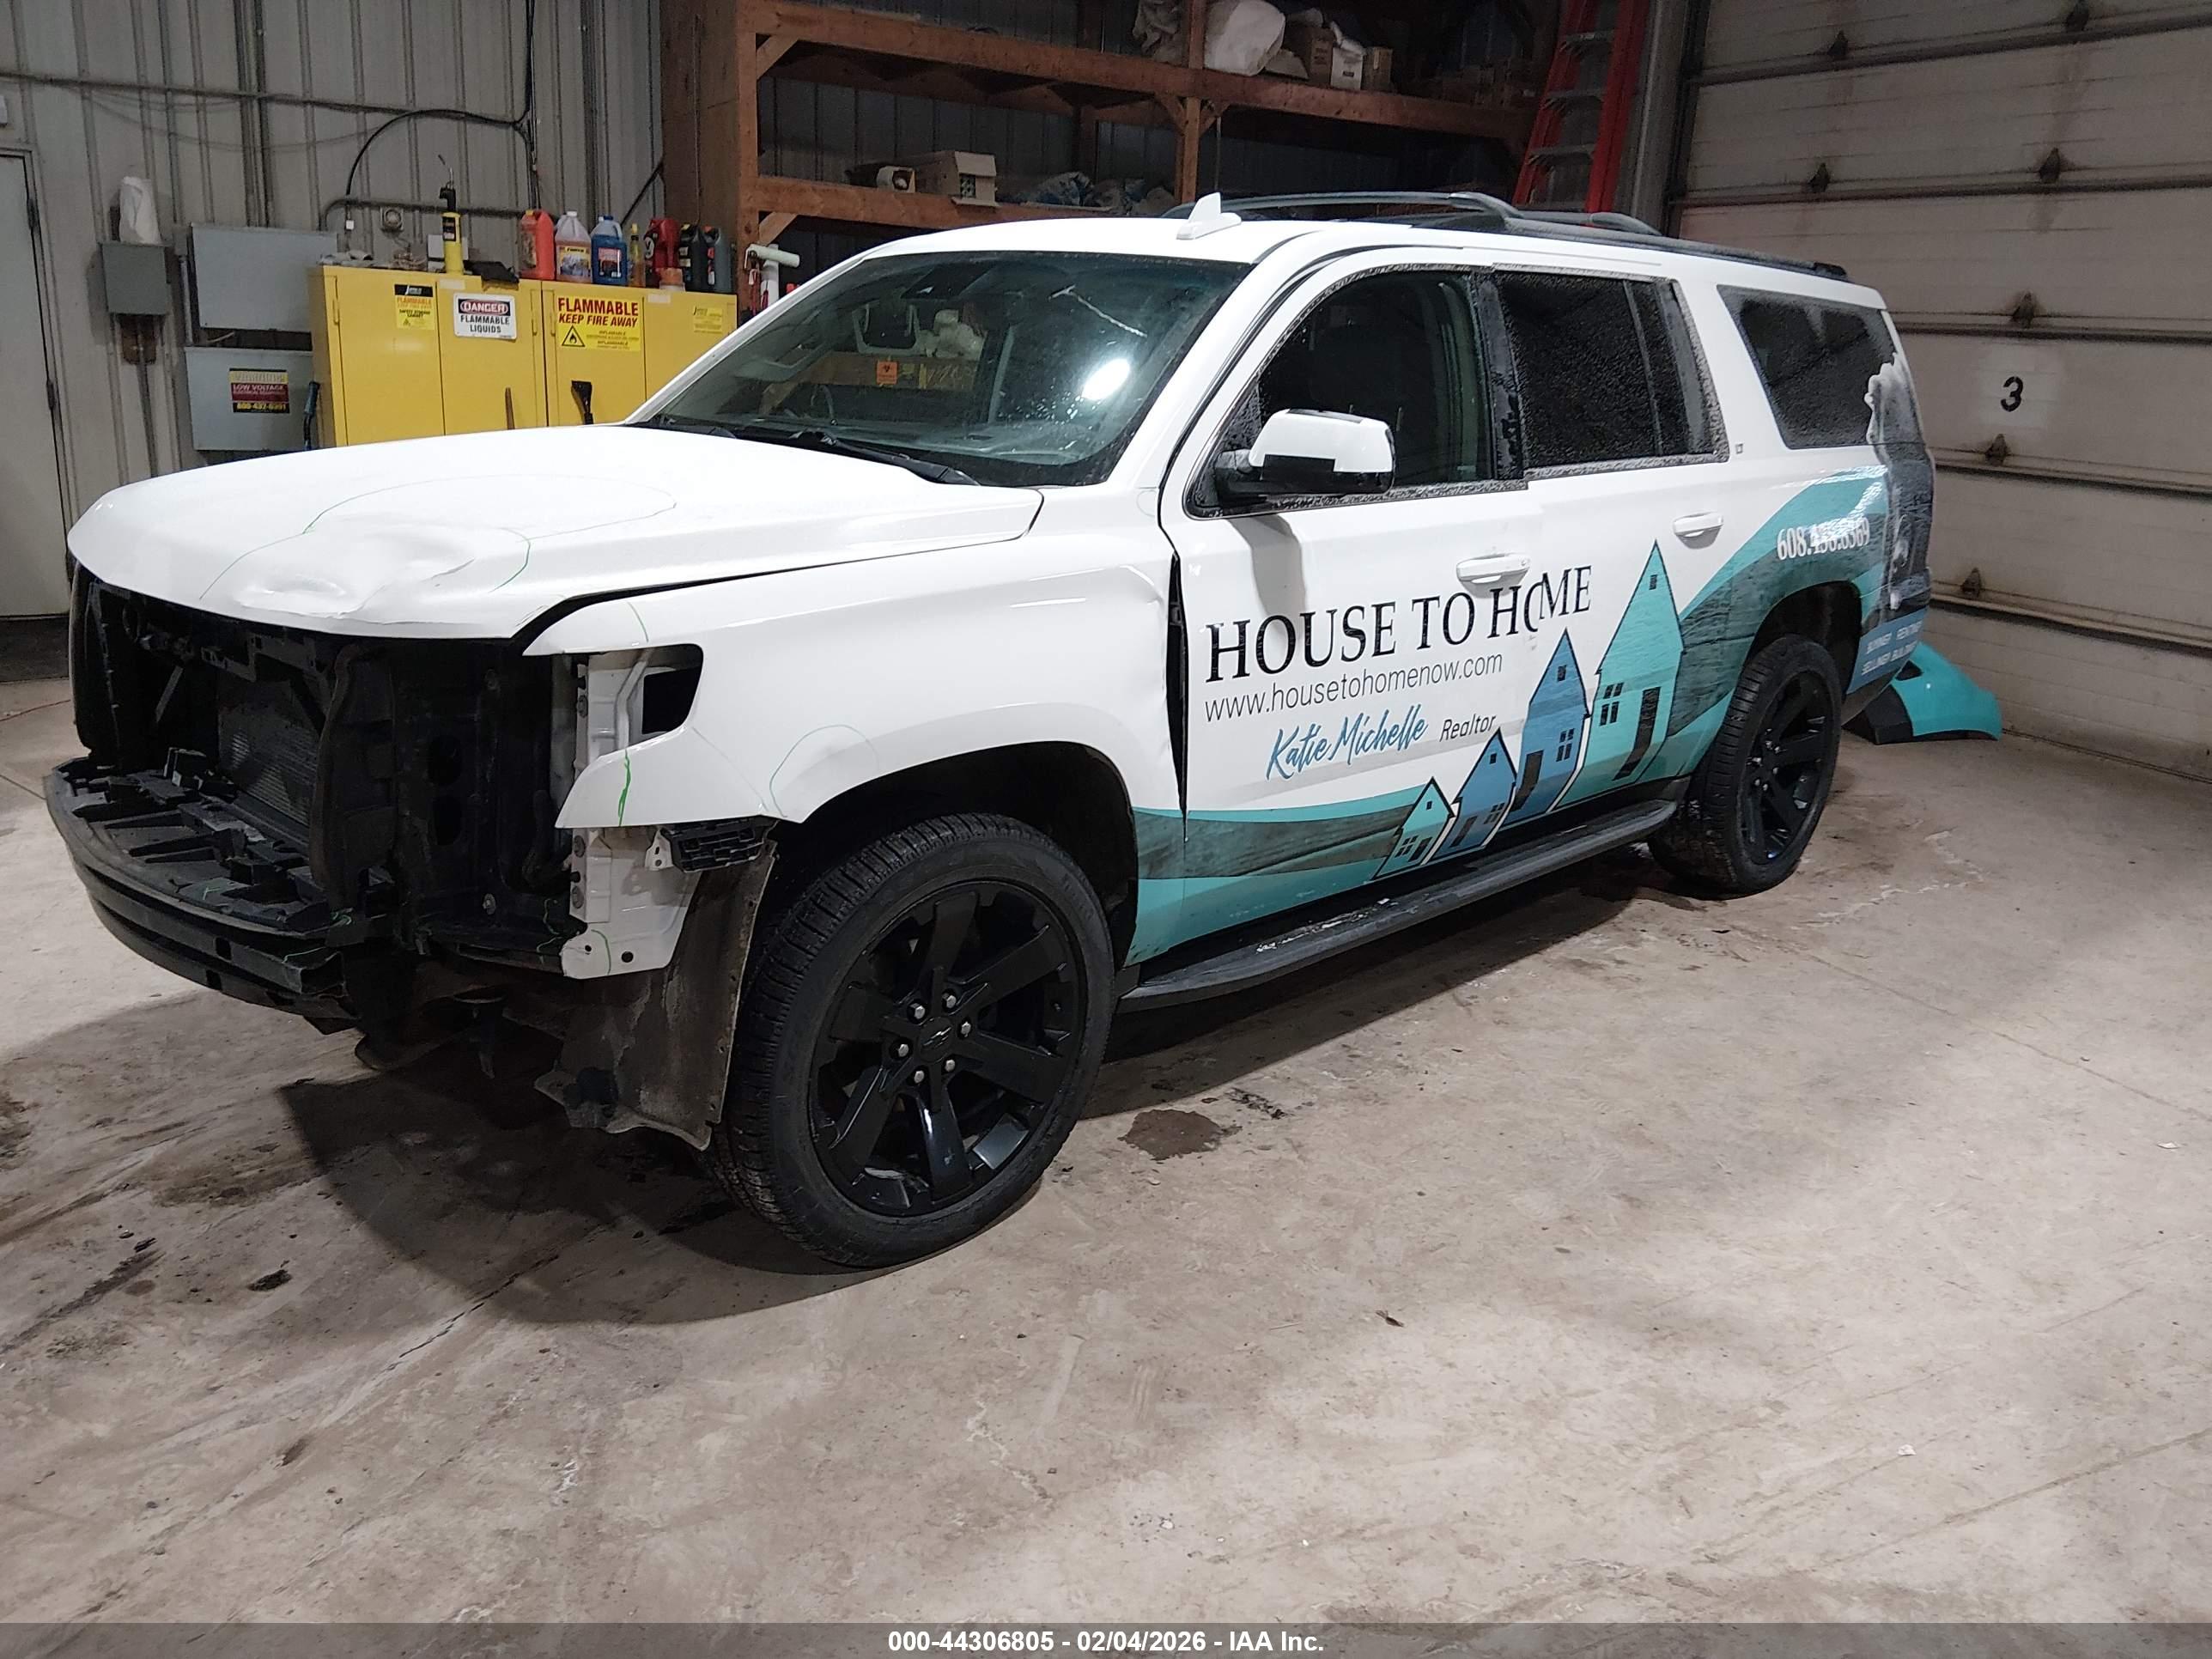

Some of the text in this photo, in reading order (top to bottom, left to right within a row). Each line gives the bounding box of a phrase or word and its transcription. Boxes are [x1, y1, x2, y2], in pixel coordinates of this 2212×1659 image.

[464, 301, 506, 313] DANGER
[558, 297, 639, 316] FLAMMABLE
[460, 314, 510, 325] FLAMMABLE
[470, 325, 501, 333] LIQUIDS
[559, 313, 637, 328] KEEP FIRE AWAY
[2000, 376, 2024, 412] 3
[1206, 565, 1593, 684] HOUSE TO HOME
[1204, 653, 1503, 723] www.housetohomenow.com
[1266, 702, 1498, 781] Katie Michelle Realtor
